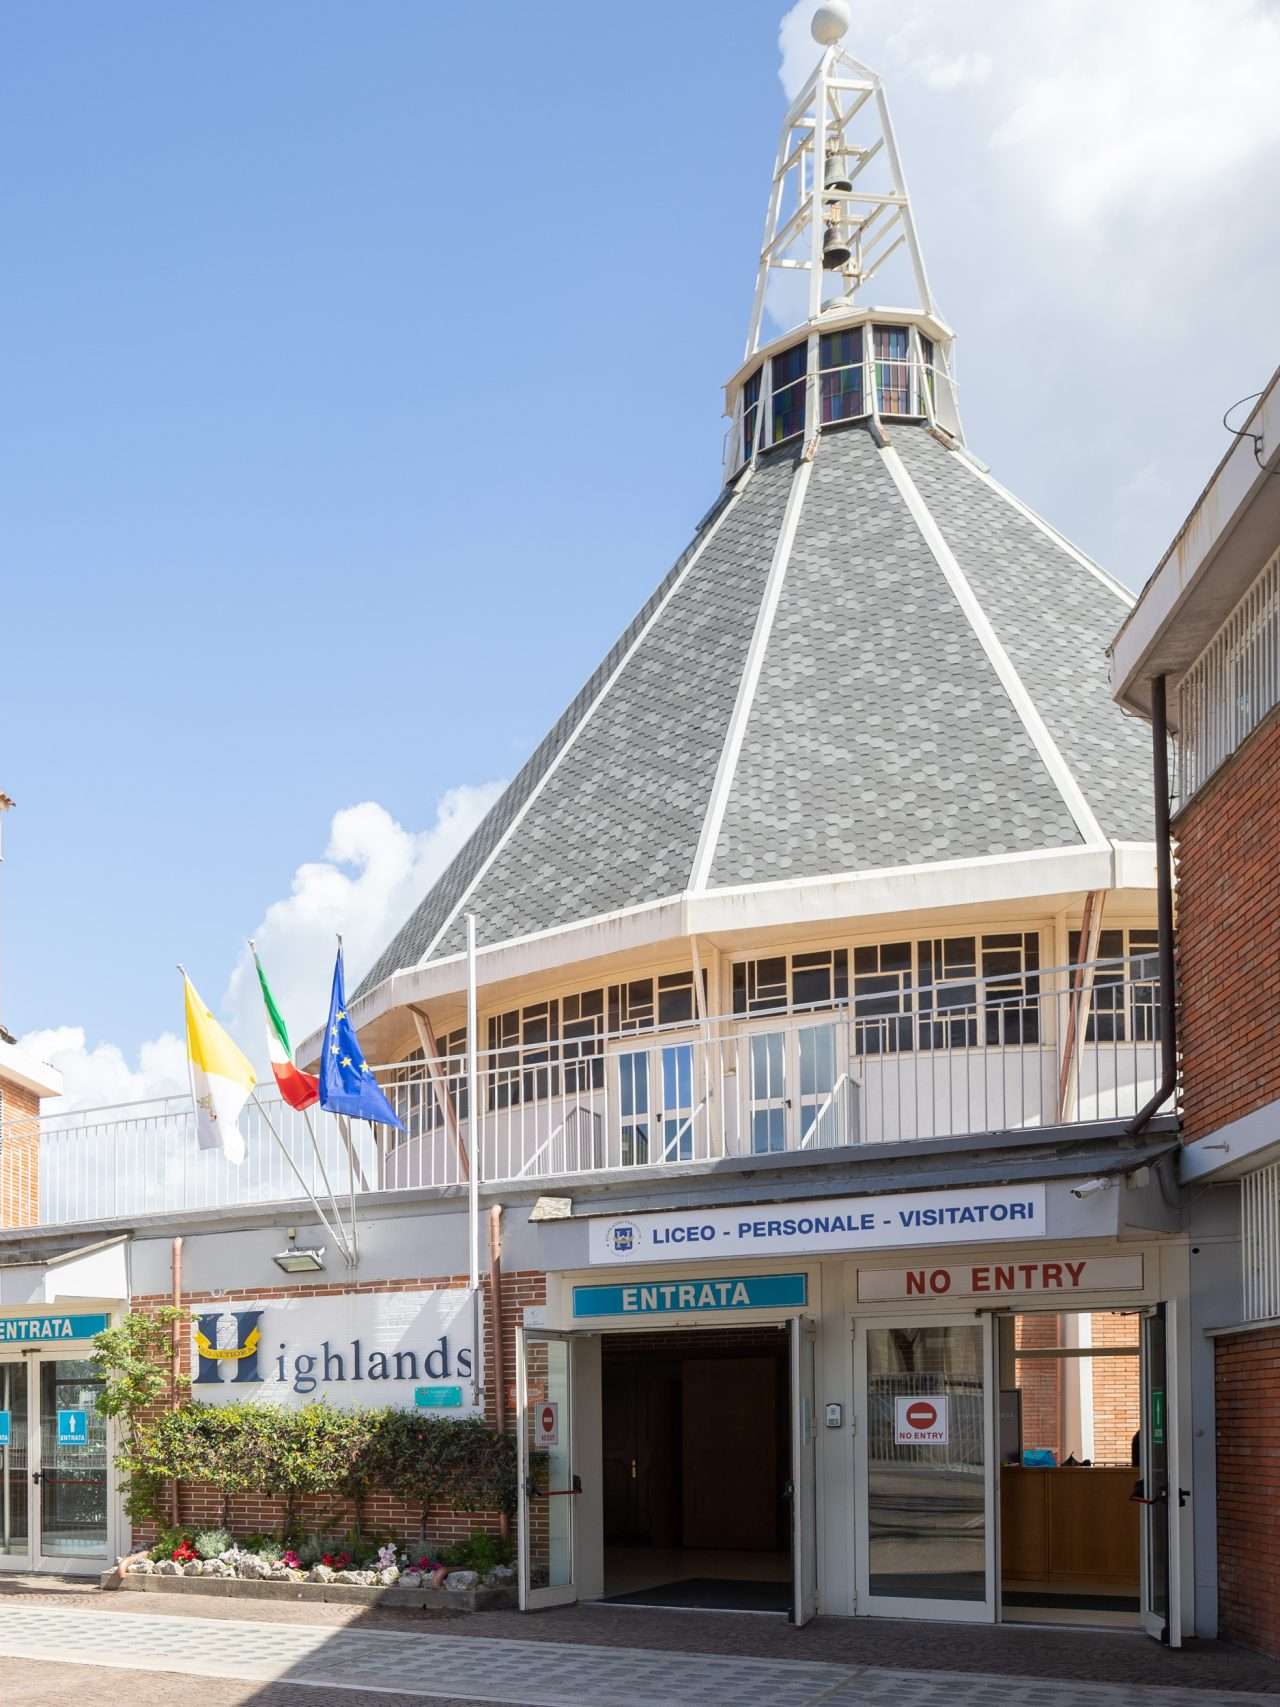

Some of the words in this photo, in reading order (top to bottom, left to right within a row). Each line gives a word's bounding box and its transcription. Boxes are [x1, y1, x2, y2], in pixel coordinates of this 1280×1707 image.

[652, 1225, 715, 1244] LICEO
[738, 1214, 874, 1238] PERSONALE
[899, 1202, 1034, 1227] VISITATORI
[906, 1269, 951, 1295] NO
[972, 1262, 1087, 1292] ENTRY
[622, 1282, 750, 1311] ENTRATA
[899, 1432, 912, 1440] NO
[914, 1431, 944, 1440] ENTRY
